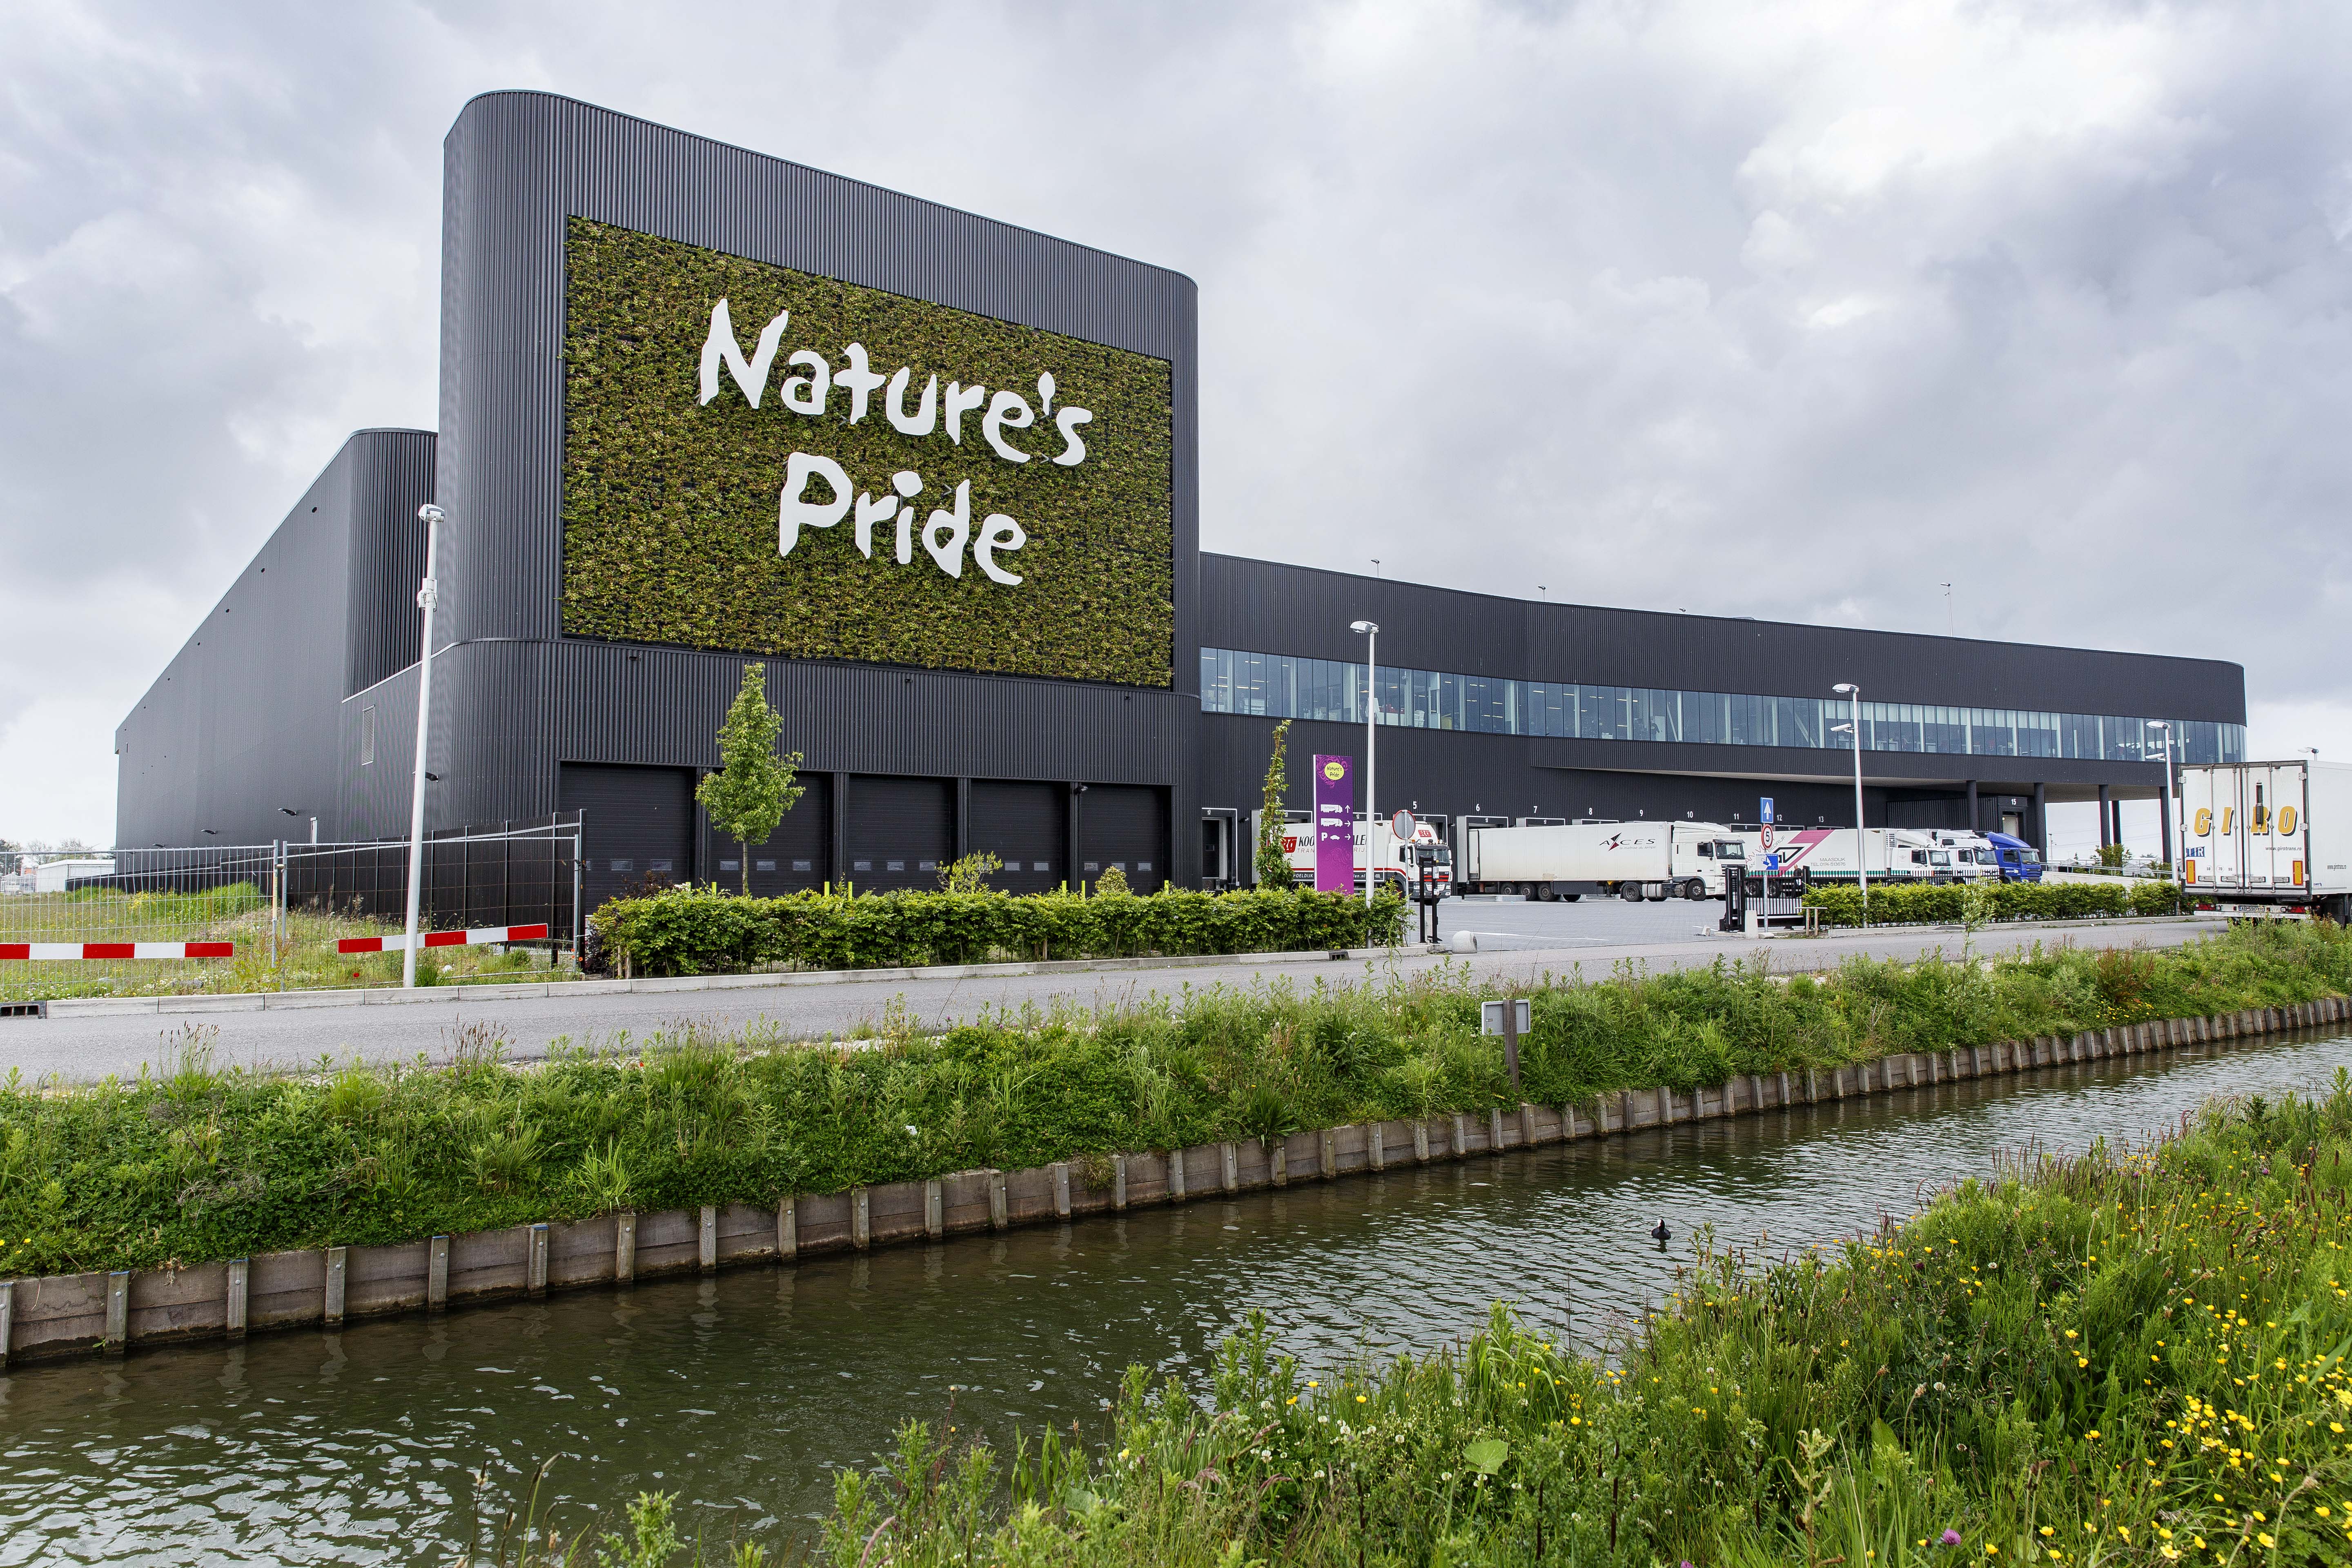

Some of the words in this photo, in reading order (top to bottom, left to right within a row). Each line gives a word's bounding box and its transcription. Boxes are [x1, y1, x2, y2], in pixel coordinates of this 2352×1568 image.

[700, 298, 1092, 466] Nature's
[779, 452, 1027, 585] Pride
[1413, 801, 1417, 809] 5
[2194, 806, 2297, 837] GIRO
[1321, 832, 1327, 841] P
[1766, 831, 1770, 842] 5
[2187, 847, 2203, 857] TIR
